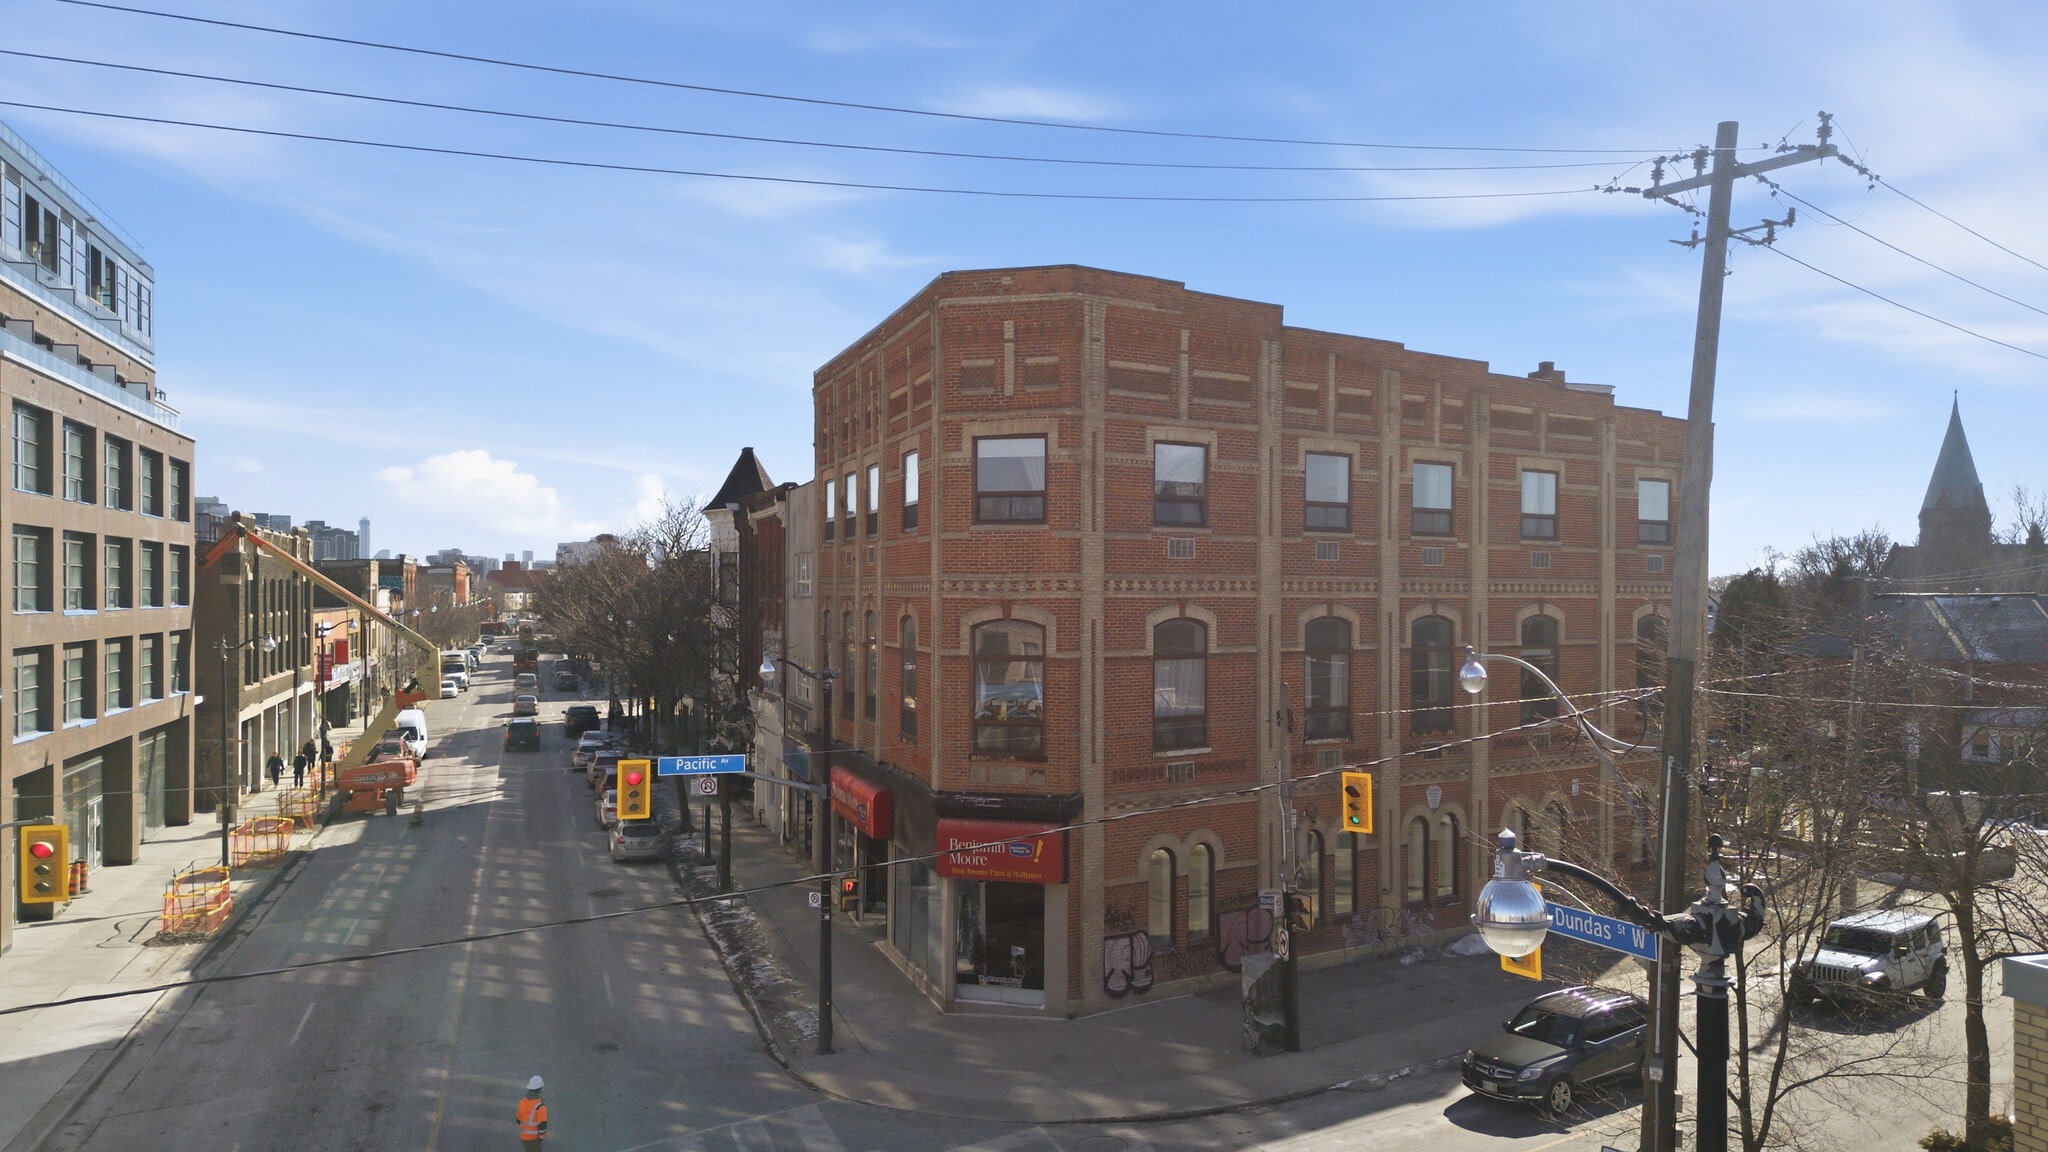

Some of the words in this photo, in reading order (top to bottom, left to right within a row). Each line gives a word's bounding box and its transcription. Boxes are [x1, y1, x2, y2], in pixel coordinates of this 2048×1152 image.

[676, 758, 716, 770] Pacific
[949, 838, 1005, 854] Benjamin
[949, 852, 988, 866] Moore
[1555, 907, 1612, 940] Dundas
[1617, 924, 1626, 936] St
[1631, 927, 1645, 949] W
